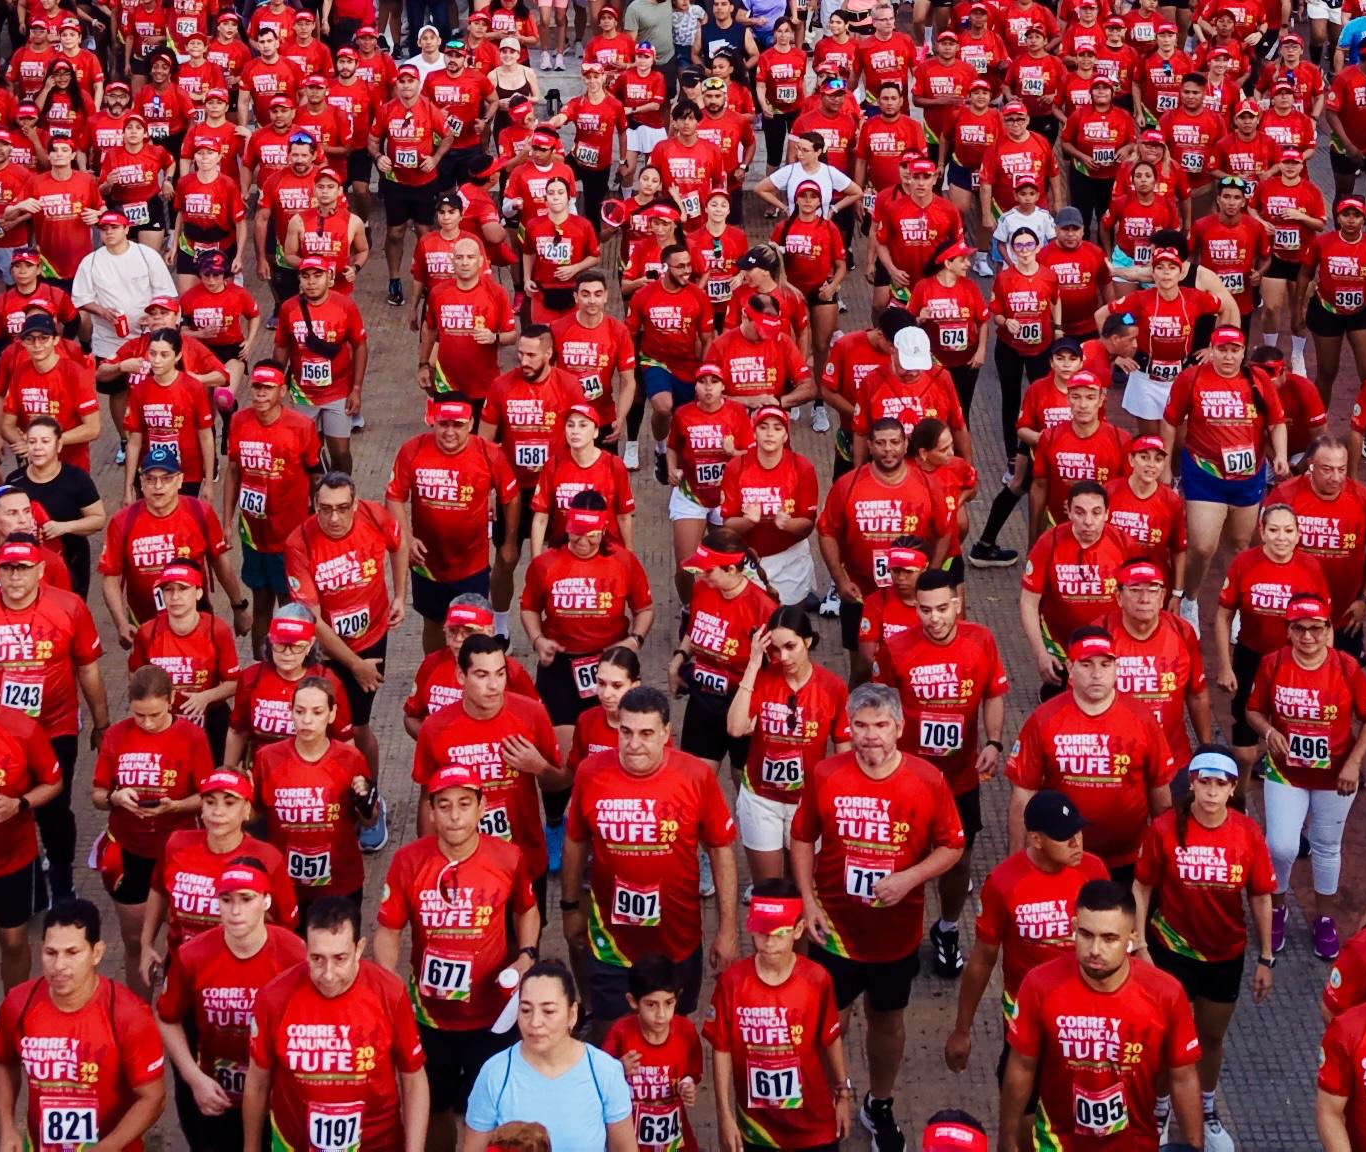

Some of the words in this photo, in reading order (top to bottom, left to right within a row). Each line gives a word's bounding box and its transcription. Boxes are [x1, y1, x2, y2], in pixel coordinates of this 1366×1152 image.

[1160, 97, 1177, 109] 251
[397, 152, 417, 164] 1275
[1182, 155, 1203, 168] 553
[127, 207, 148, 222] 1224
[1277, 230, 1298, 244] 2617
[547, 243, 568, 258] 2516
[709, 282, 731, 295] 1376
[1336, 294, 1362, 306] 396
[942, 331, 965, 345] 674
[304, 364, 330, 379] 1566
[518, 447, 546, 465] 1581
[1227, 452, 1253, 472] 670
[242, 491, 263, 511] 763
[855, 500, 891, 510] CORRE
[894, 500, 902, 510] Y
[856, 509, 902, 518] ANUNCIA
[904, 515, 918, 524] 20
[856, 518, 879, 531] TU
[882, 518, 902, 532] FE
[904, 524, 916, 532] 26
[336, 614, 368, 635] 1208
[6, 685, 39, 707] 1243
[924, 723, 960, 748] 709
[1290, 736, 1328, 759] 496
[765, 761, 799, 782] 726
[596, 799, 642, 811] CORRE
[645, 799, 656, 811] Y
[597, 811, 656, 823] ANUNCIA
[597, 823, 625, 842] TU
[629, 824, 657, 842] FE
[660, 820, 679, 831] 20
[660, 832, 676, 842] 26
[291, 856, 327, 877] 957
[619, 891, 658, 917] 907
[429, 960, 467, 989] 677
[1056, 1015, 1107, 1029] CORRE
[1110, 1018, 1121, 1031] Y
[287, 1024, 337, 1037] CORRE
[339, 1025, 350, 1038] Y
[1058, 1028, 1120, 1044] ANUNCIA
[287, 1038, 351, 1050] ANUNCIA
[1059, 1040, 1089, 1058] TU
[1094, 1042, 1120, 1061] FE
[1124, 1042, 1143, 1053] 20
[356, 1046, 374, 1059] 20
[1123, 1054, 1141, 1063] 26
[286, 1051, 318, 1071] TU
[322, 1052, 353, 1071] FE
[356, 1059, 375, 1072] 26
[756, 1071, 794, 1098] 617
[1077, 1096, 1124, 1130] 095
[49, 1112, 94, 1141] 821
[315, 1118, 357, 1147] 1197
[640, 1110, 680, 1143] 634
